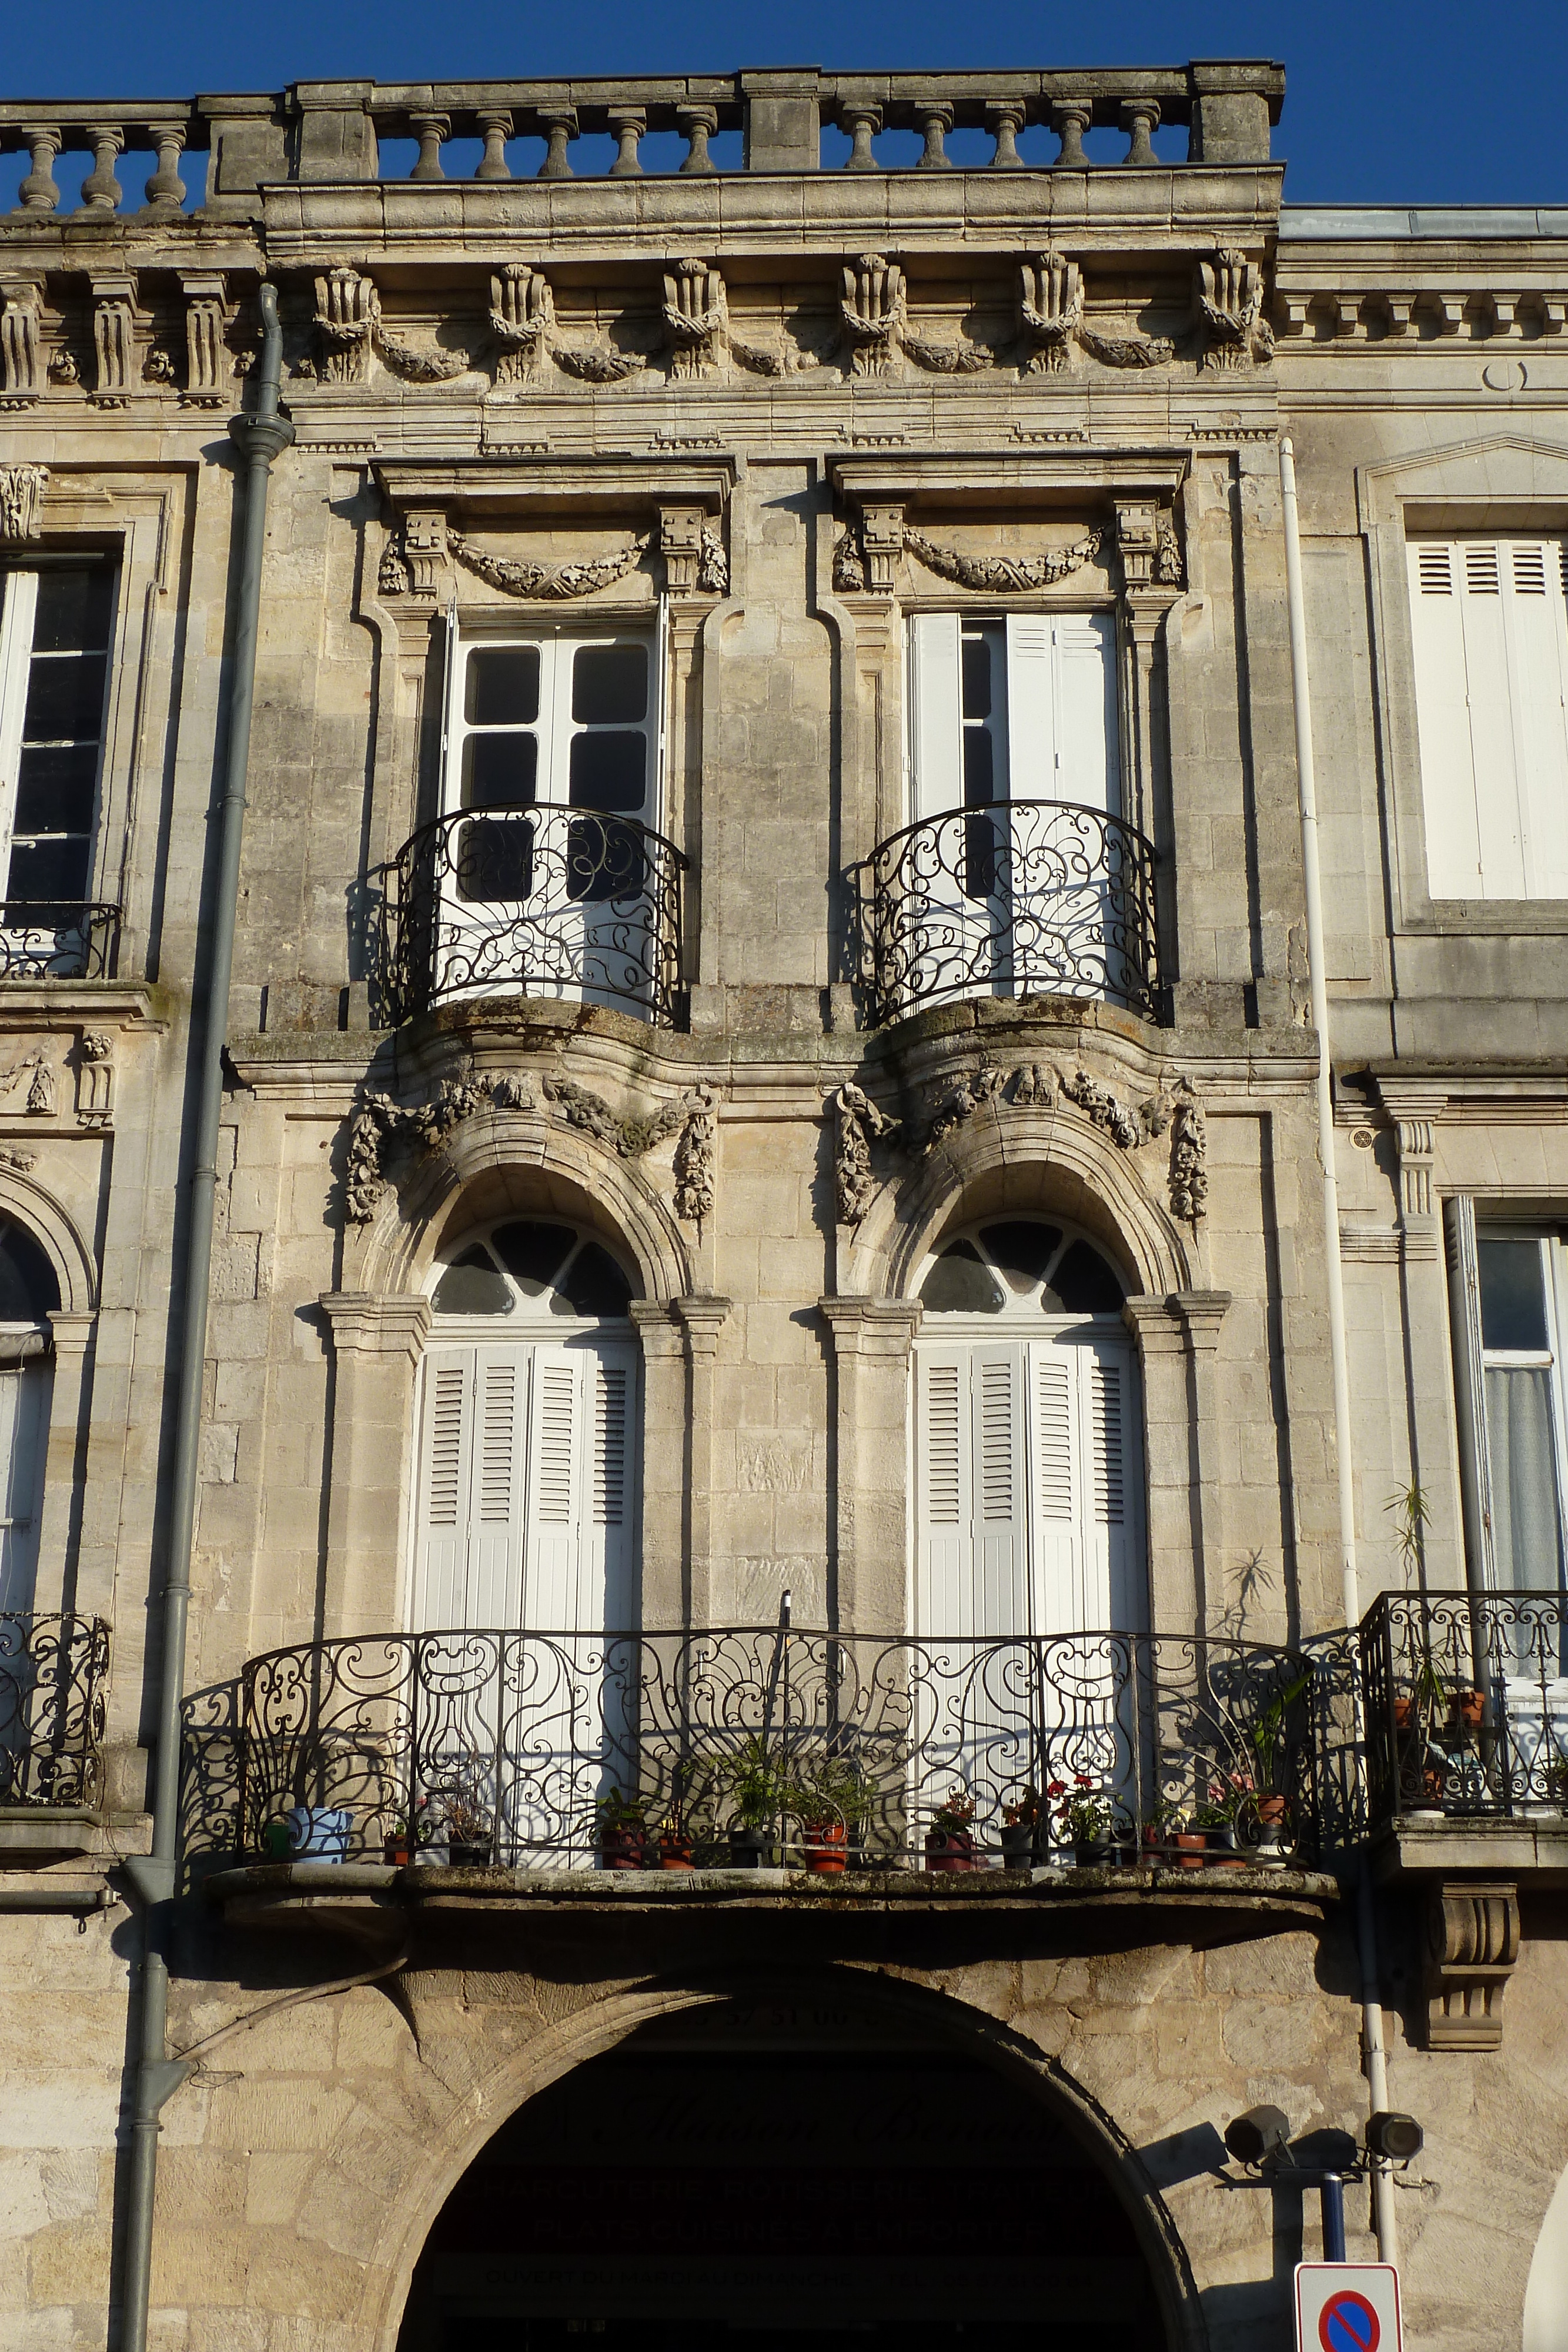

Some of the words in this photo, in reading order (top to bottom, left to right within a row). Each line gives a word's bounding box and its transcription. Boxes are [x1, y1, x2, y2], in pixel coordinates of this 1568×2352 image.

[591, 2093, 821, 2146] Maison
[459, 2179, 713, 2204] CHARCUTERIE,
[723, 2176, 935, 2204] RÔTISSERIE,
[945, 2180, 1115, 2203] TRAITEUR
[533, 2219, 640, 2240] PLATS
[651, 2212, 812, 2241] CUISINÉS
[821, 2214, 844, 2241] À
[853, 2219, 1047, 2241] EMPORTER
[486, 2270, 576, 2284] OUVERT
[582, 2271, 613, 2285] DU
[621, 2271, 691, 2286] MARDI
[696, 2271, 727, 2286] AU
[733, 2272, 853, 2287] DIMANCHE
[942, 2273, 969, 2288] 05
[1032, 2274, 1060, 2288] 00
[1066, 2274, 1093, 2288] 84
